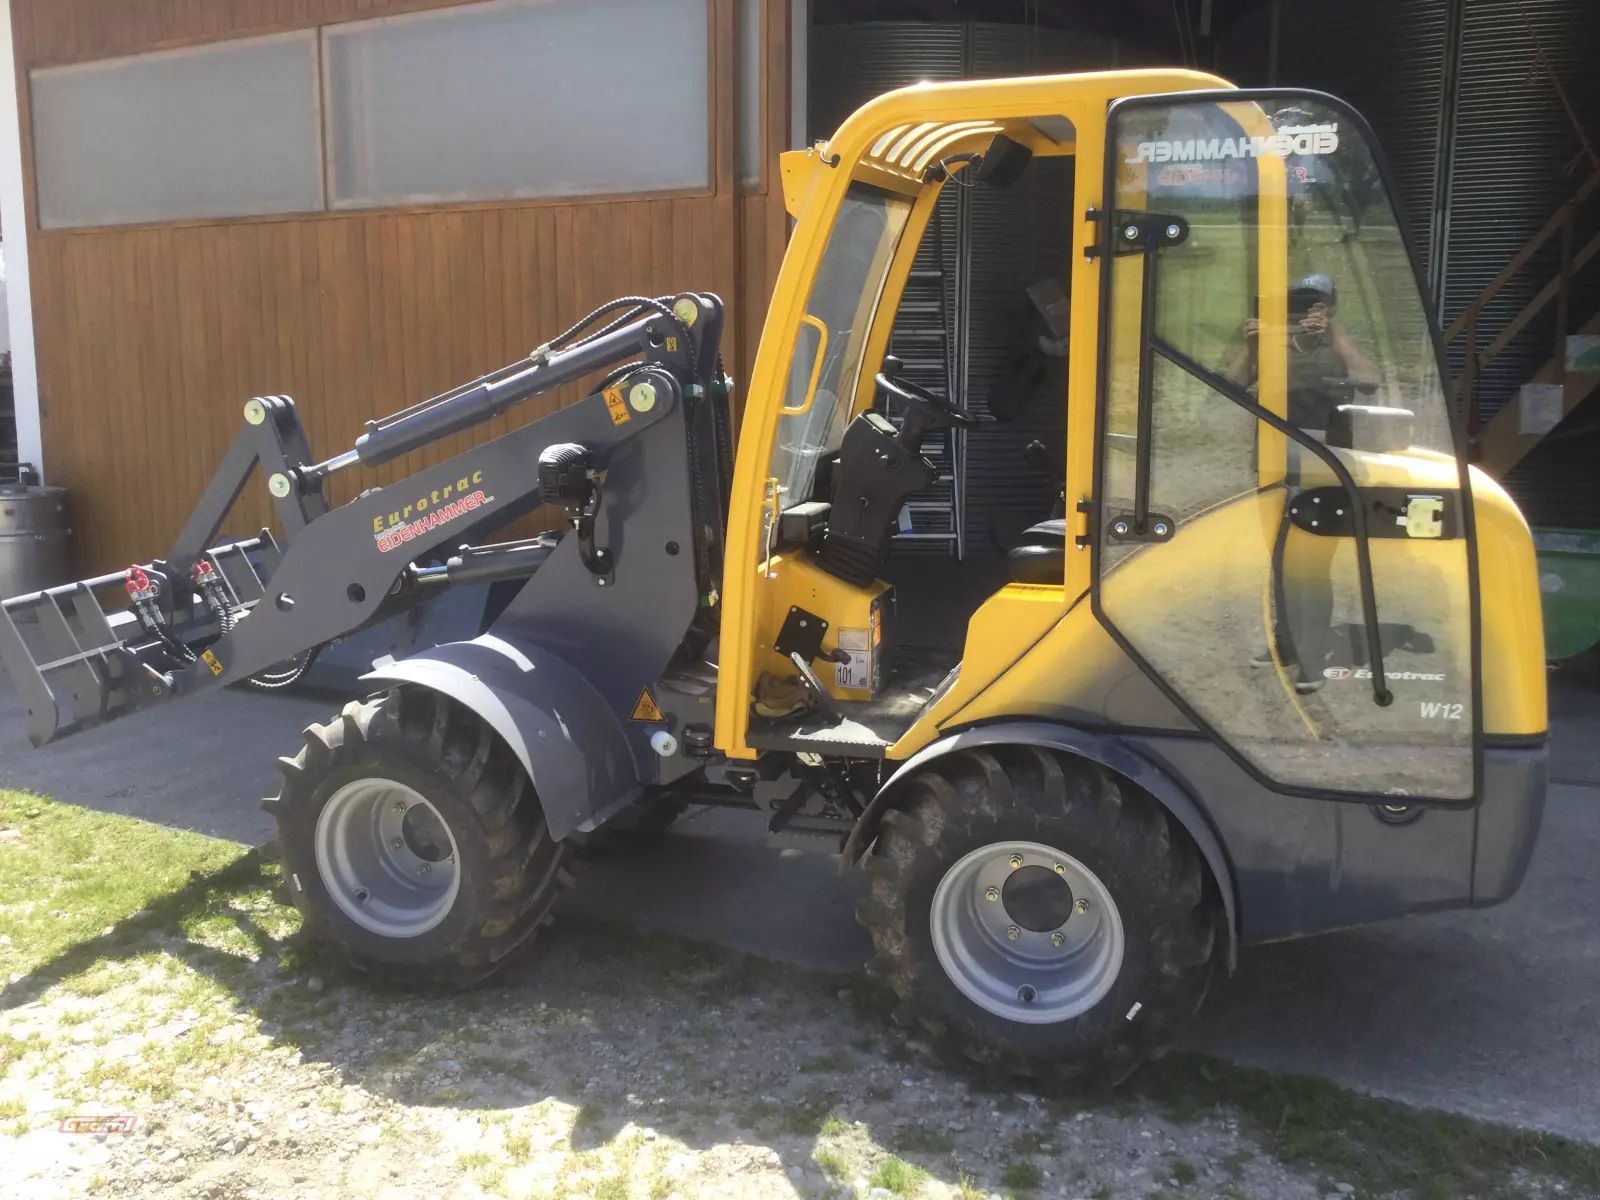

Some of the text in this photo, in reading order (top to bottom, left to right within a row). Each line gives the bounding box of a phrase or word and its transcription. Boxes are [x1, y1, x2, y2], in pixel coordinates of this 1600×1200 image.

[372, 469, 483, 532] Eurotrac
[376, 490, 487, 553] EIDENHAMMER
[837, 666, 852, 684] 101
[1420, 702, 1463, 719] W12
